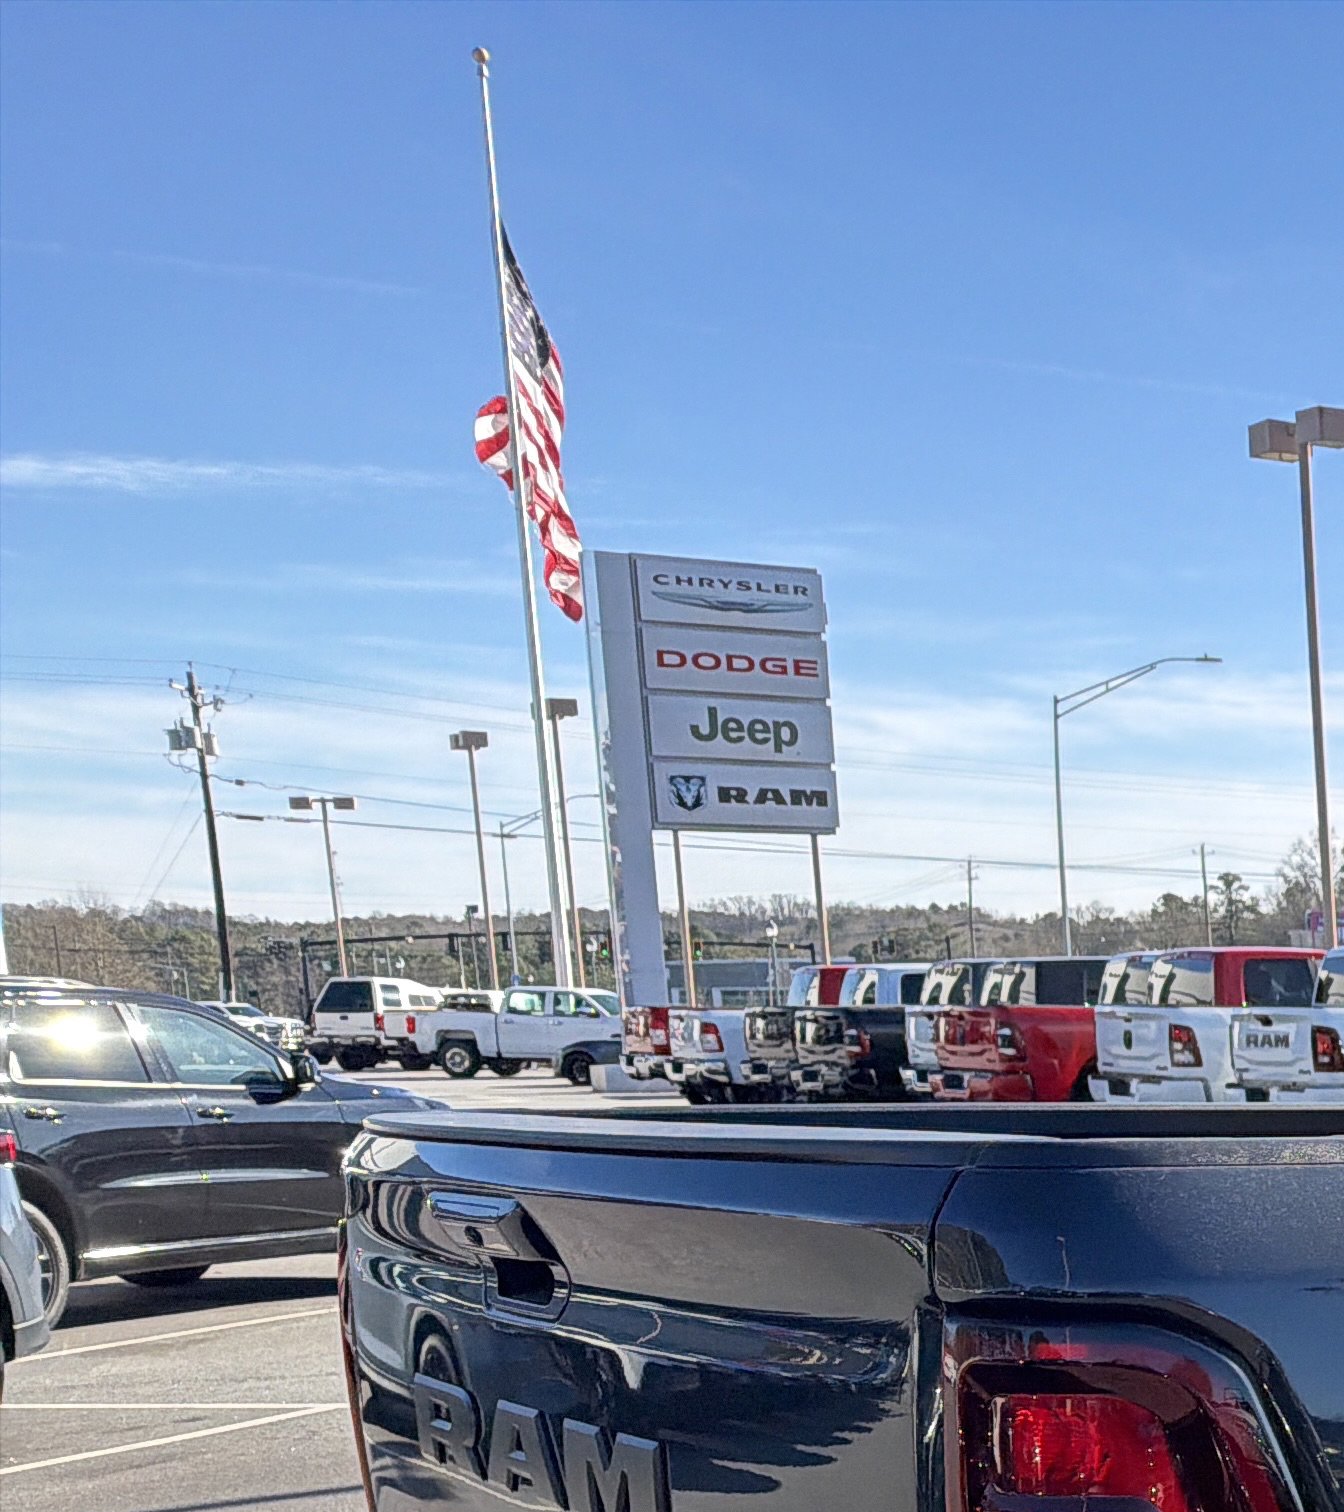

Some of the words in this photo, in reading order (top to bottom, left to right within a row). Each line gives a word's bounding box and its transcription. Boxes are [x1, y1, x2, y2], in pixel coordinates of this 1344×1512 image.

[653, 574, 809, 596] CHRYSLER
[656, 650, 819, 678] DODGE
[690, 706, 799, 752] Jeep
[717, 785, 829, 807] RAM
[1245, 1032, 1290, 1048] RAM
